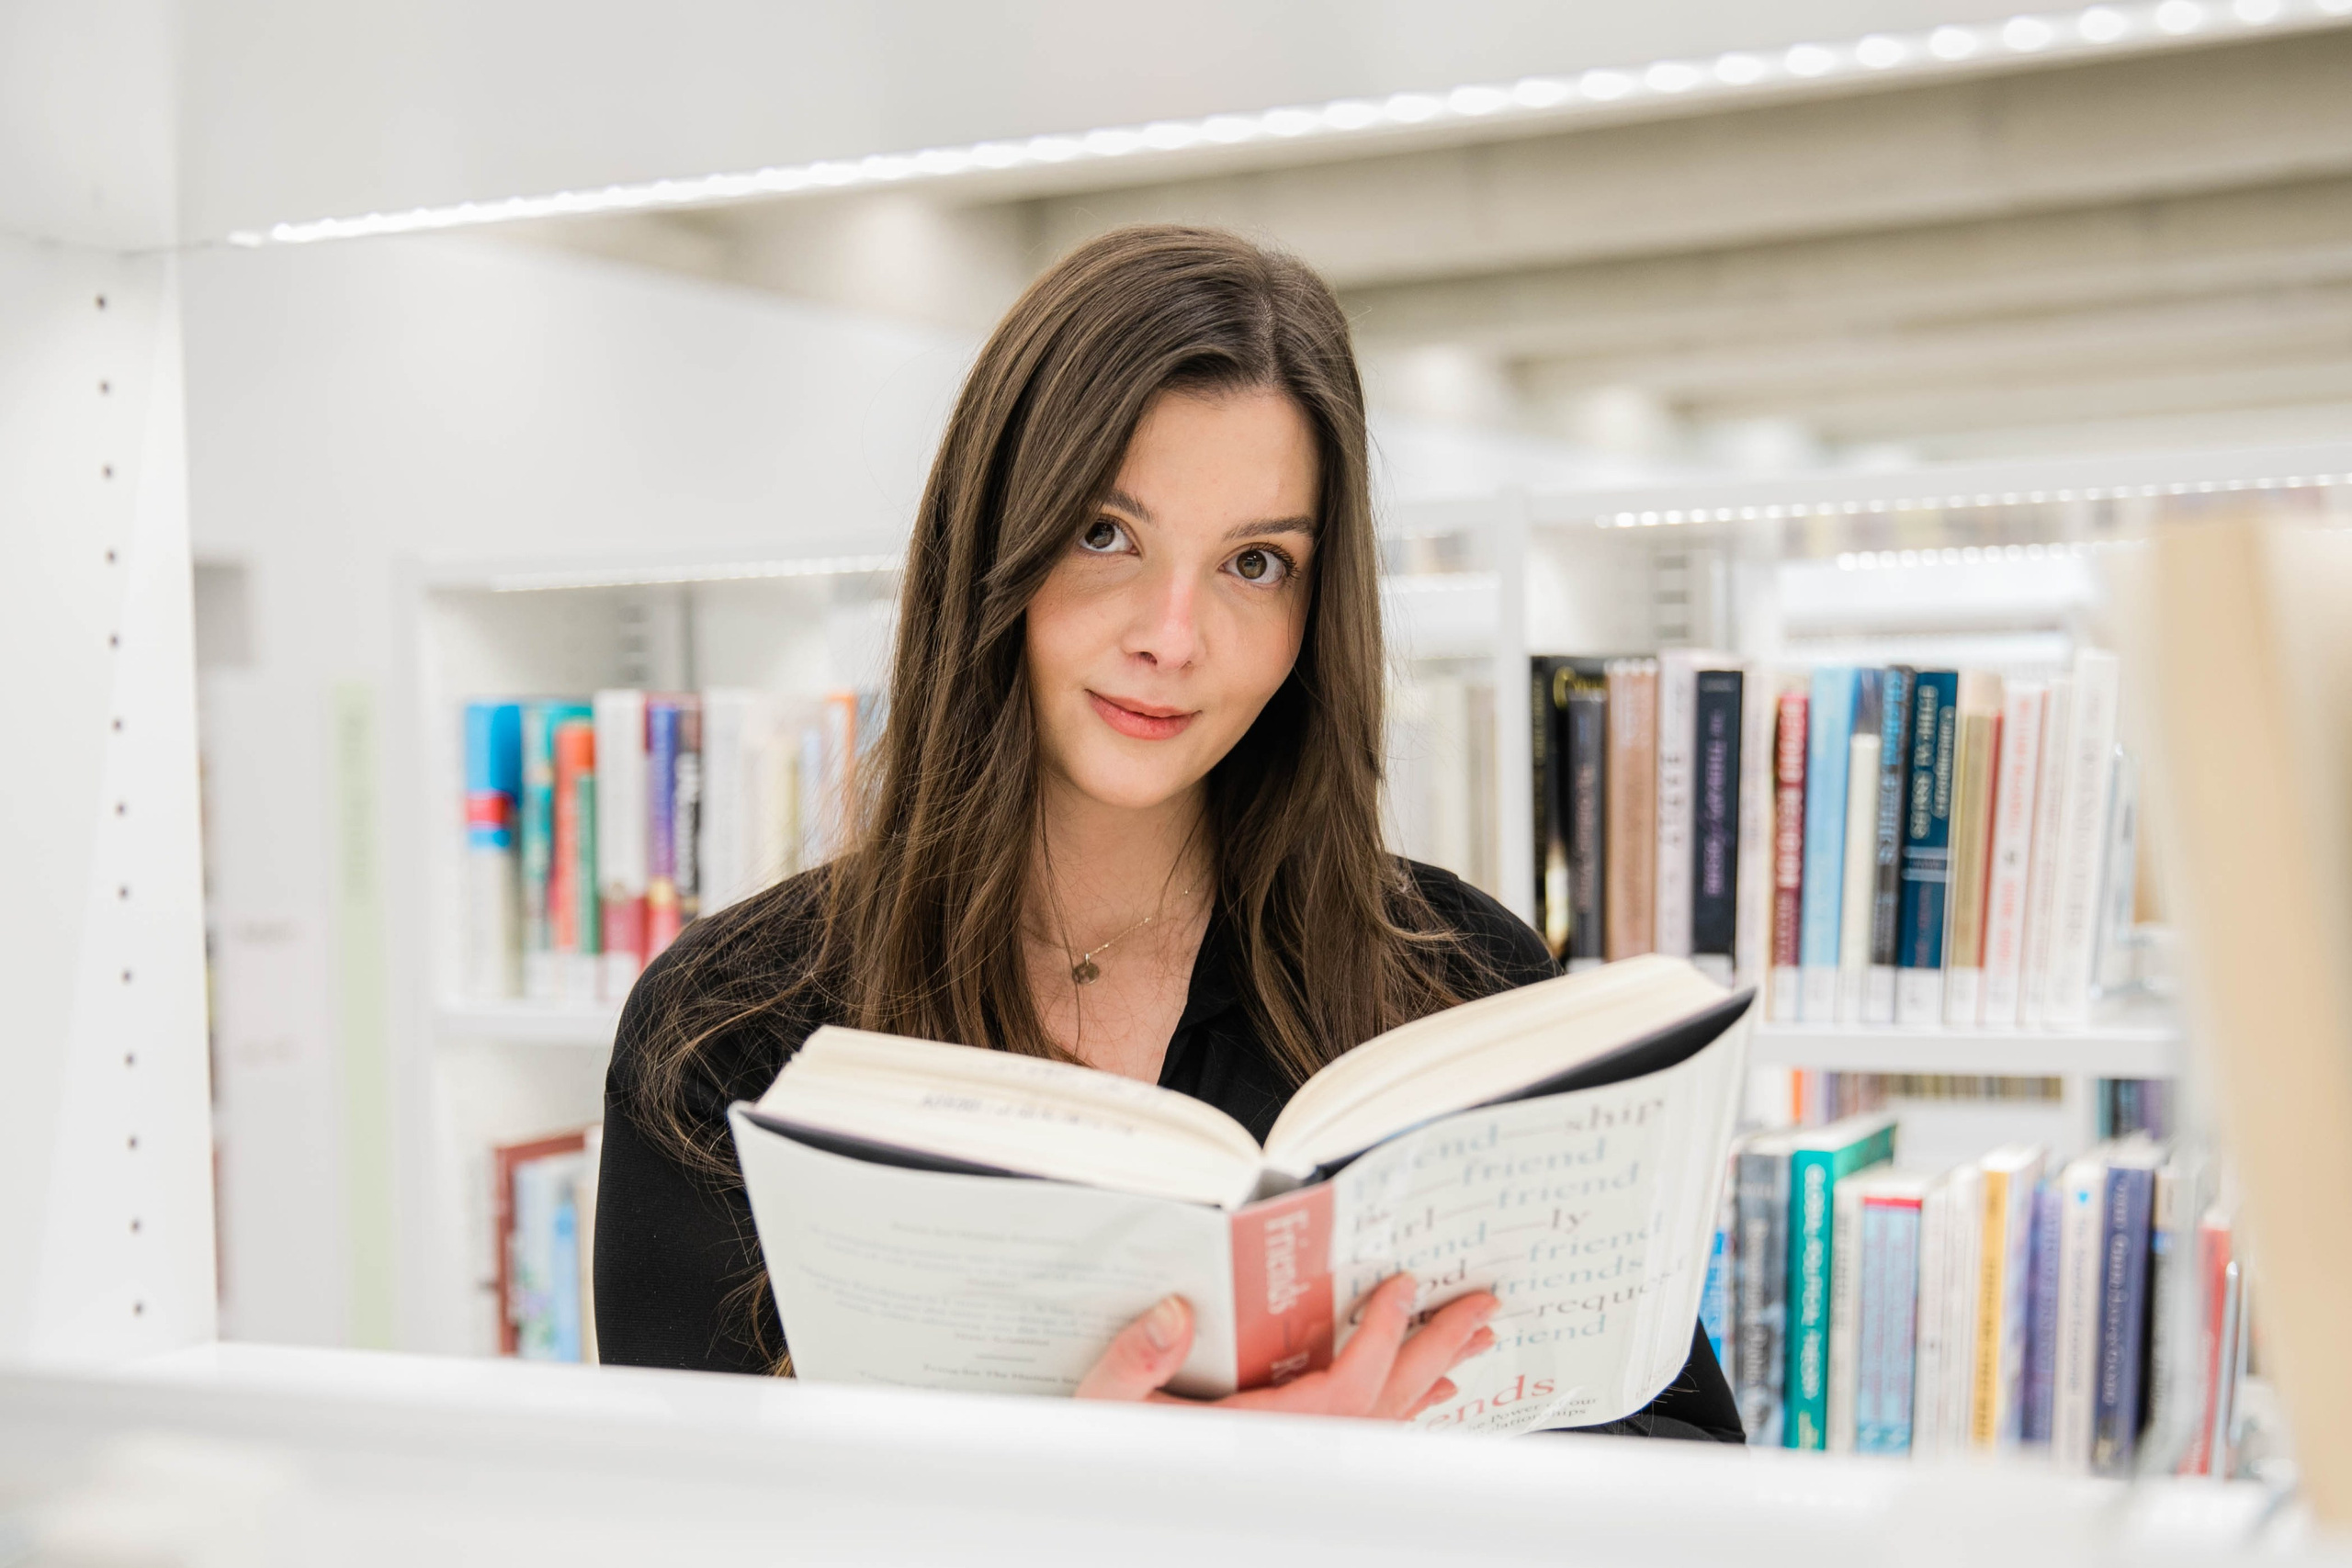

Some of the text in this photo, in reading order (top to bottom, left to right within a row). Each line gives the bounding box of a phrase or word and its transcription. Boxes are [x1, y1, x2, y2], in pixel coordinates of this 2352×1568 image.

[1461, 1136, 1607, 1189] friend
[1497, 1161, 1641, 1211] friend
[1264, 1208, 1312, 1314] Friends
[1529, 1210, 1664, 1264] friend
